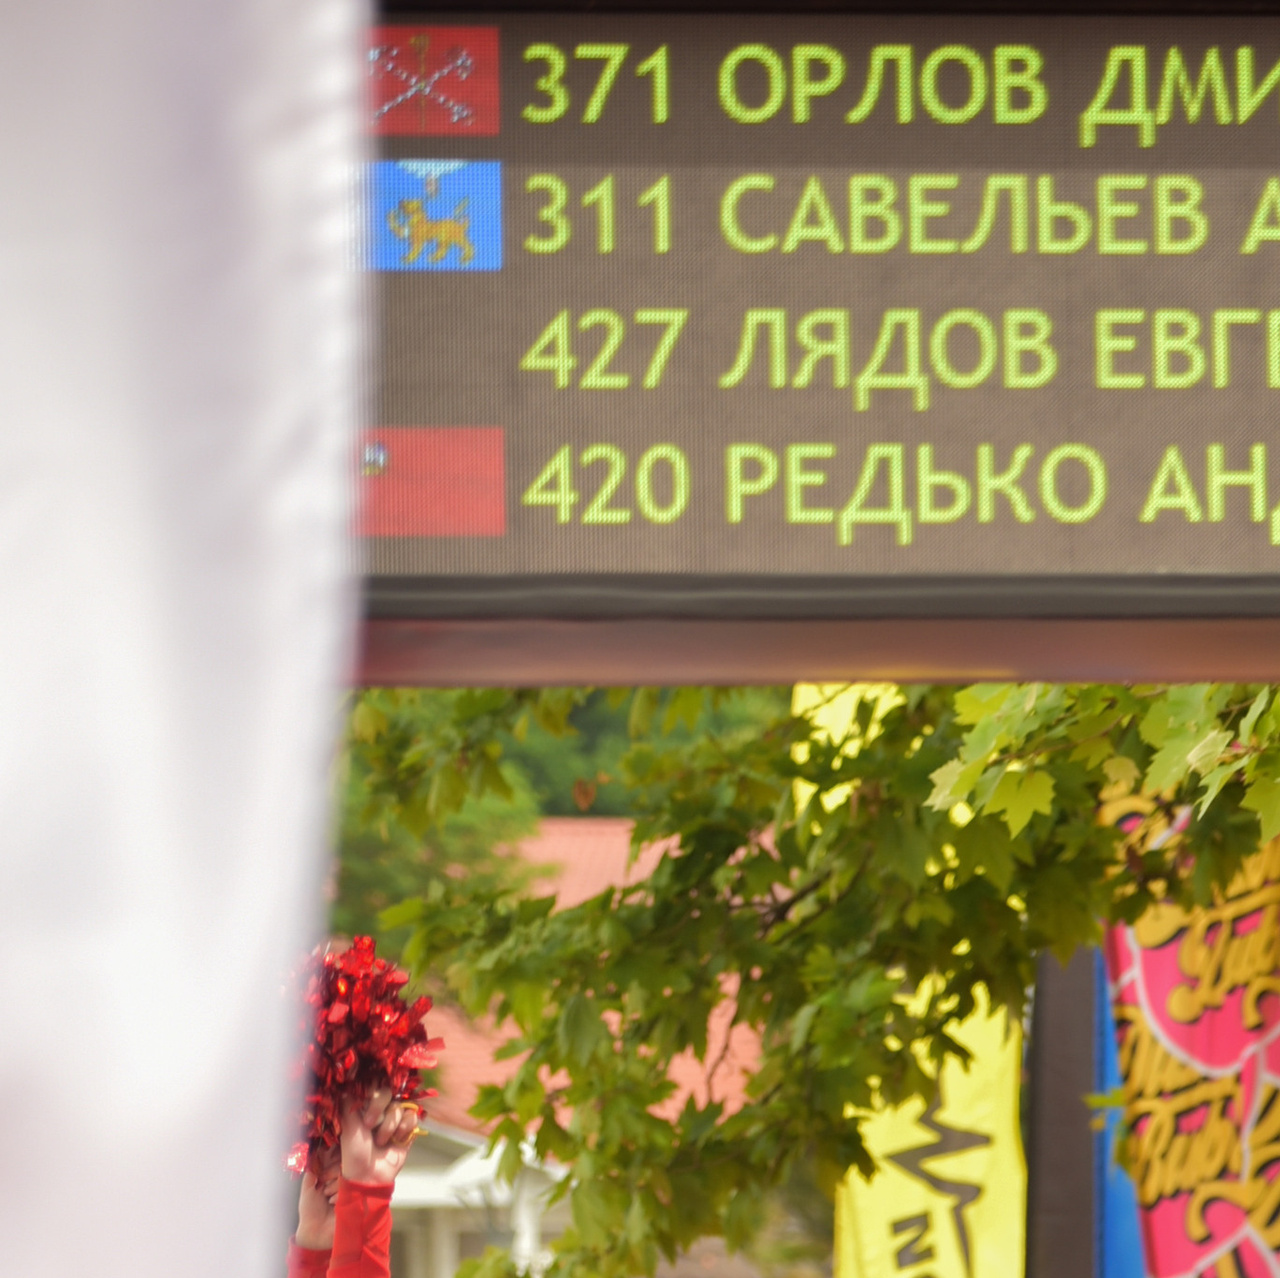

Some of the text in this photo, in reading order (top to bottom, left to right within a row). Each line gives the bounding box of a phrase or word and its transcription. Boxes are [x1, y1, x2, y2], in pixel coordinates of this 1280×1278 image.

[520, 43, 670, 124] 371
[717, 43, 1049, 125] ОРЛОВ
[522, 173, 670, 254] 311
[719, 173, 1209, 256] САВЕЛЬЕВ
[519, 308, 690, 390] 427
[718, 308, 1058, 412] ЛЯДОВ
[521, 443, 692, 525] 420
[725, 442, 1107, 546] РЕДЬКО
